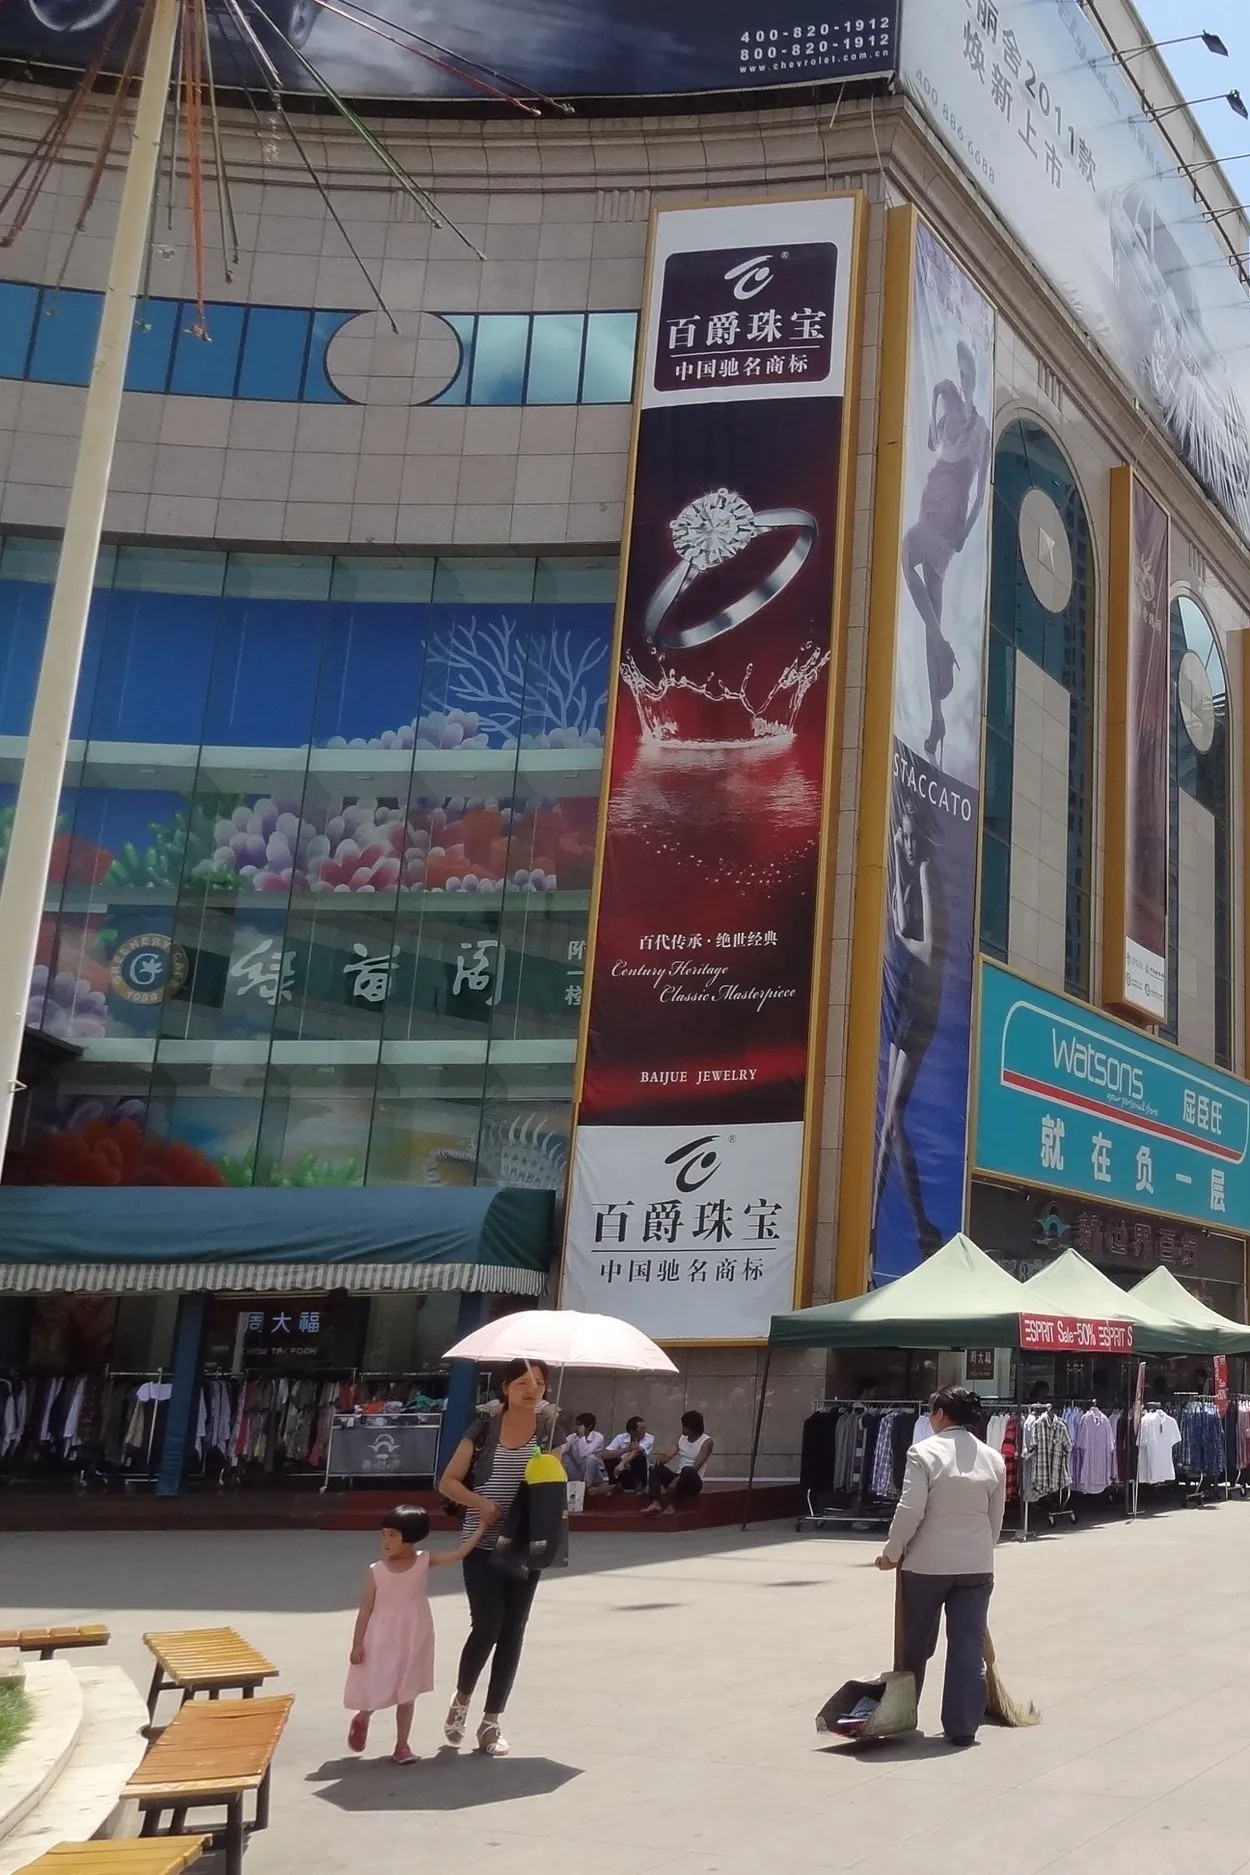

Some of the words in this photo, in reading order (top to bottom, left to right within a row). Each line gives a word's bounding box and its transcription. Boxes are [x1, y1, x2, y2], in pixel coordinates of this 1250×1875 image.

[741, 17, 889, 43] 400-820-1912
[739, 49, 889, 74] www.chevrolet.com.cn
[740, 34, 889, 61] 800-820-1912
[962, 20, 1064, 190] 焕新上市
[964, 0, 1096, 192] 丽舍2011款
[914, 69, 939, 106] 400
[942, 103, 965, 142] 886
[967, 140, 996, 185] 6688
[666, 307, 827, 350] 百爵珠宝
[675, 354, 809, 382] 中国驰名商标
[893, 752, 972, 822] STACCATO
[610, 958, 666, 989] Century
[668, 959, 729, 988] Heritage
[659, 984, 710, 1003] Classic
[711, 984, 797, 1013] Masterpiece
[640, 1071, 688, 1085] BAIJUE
[696, 1069, 758, 1085] JEWELRY
[1183, 1088, 1223, 1135] 屈臣氏
[1040, 1114, 1226, 1212] 就在负一层
[591, 1197, 783, 1244] 百爵珠宝
[600, 1257, 765, 1283] 中国驰名商标
[244, 1311, 320, 1333] 周大福
[1024, 1319, 1054, 1343] ESPRIT
[1098, 1325, 1126, 1347] ESPRIT
